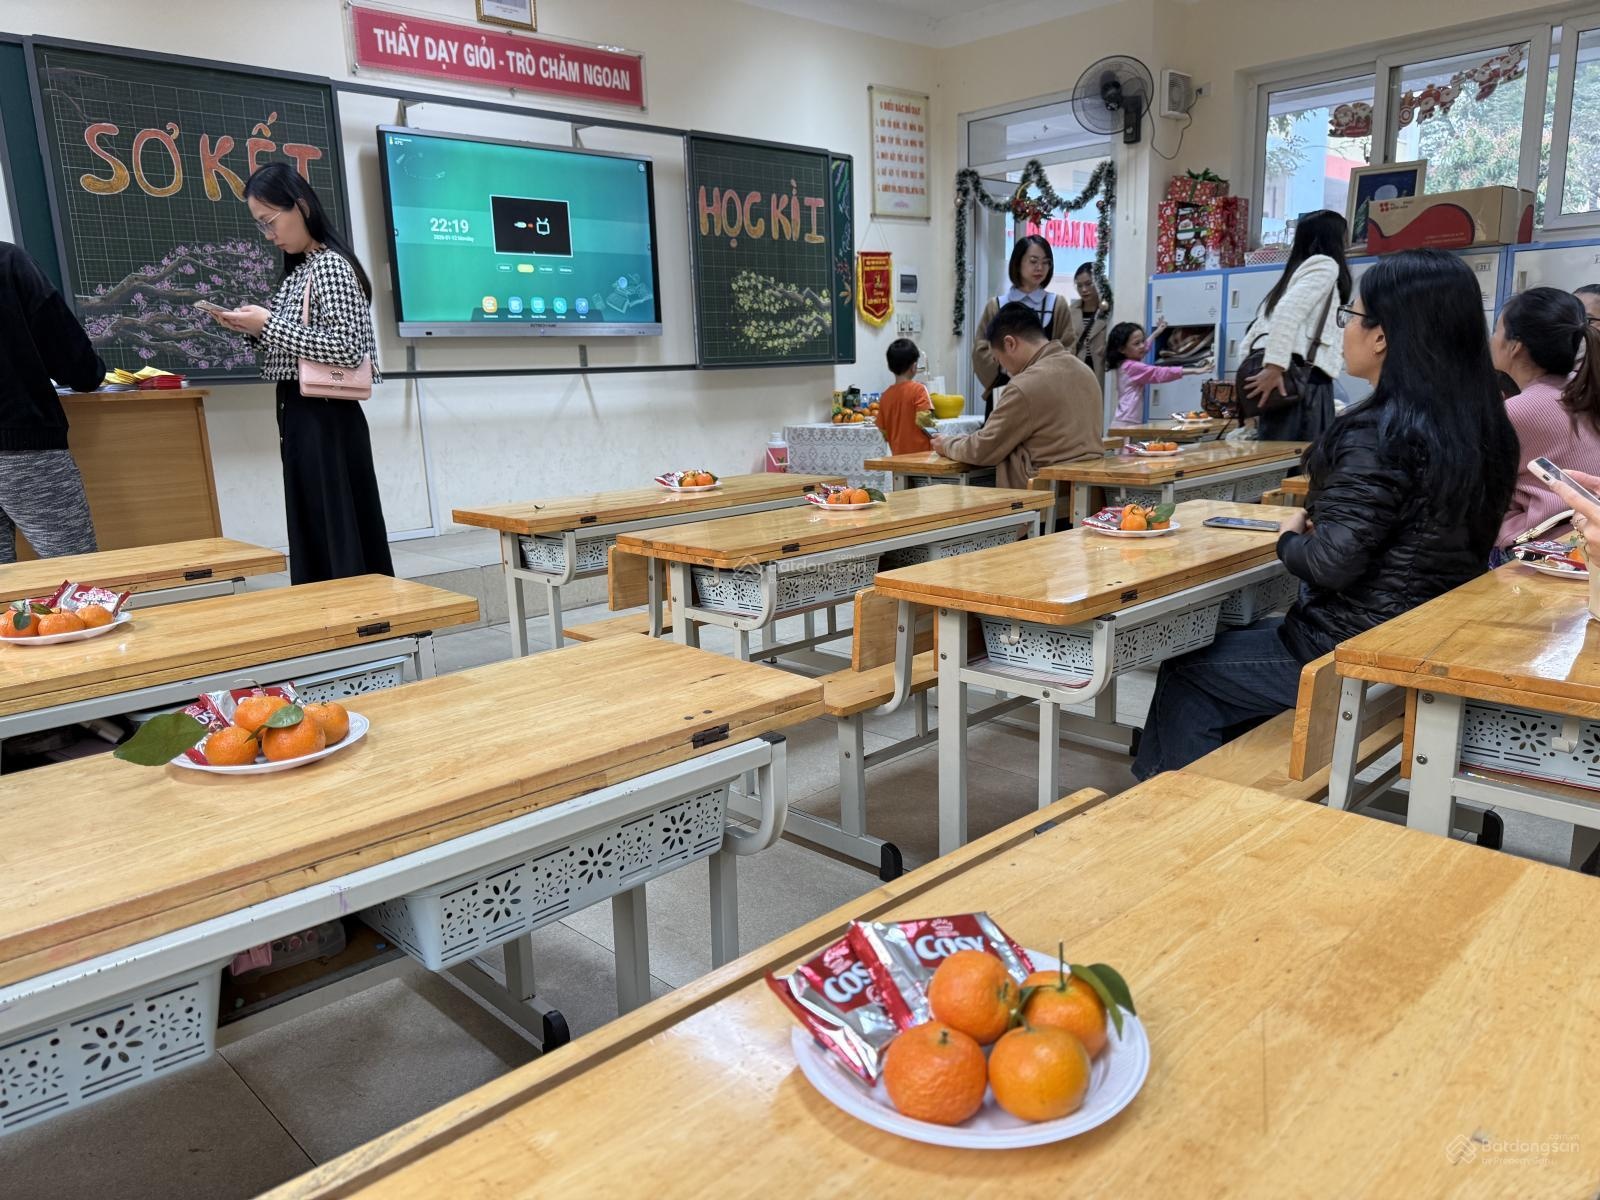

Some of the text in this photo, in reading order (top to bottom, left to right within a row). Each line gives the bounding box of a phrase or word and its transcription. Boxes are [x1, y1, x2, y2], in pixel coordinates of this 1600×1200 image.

[373, 23, 420, 58] THẦY
[425, 36, 458, 70] DẠY
[464, 36, 496, 70] GIỎI
[506, 48, 536, 77] TRÒ
[539, 53, 580, 84] CHĂM
[583, 63, 631, 92] NGOAN
[80, 122, 183, 198] SƠ
[430, 217, 469, 233] 22:19
[698, 185, 765, 248] HỌC
[804, 197, 825, 244] I
